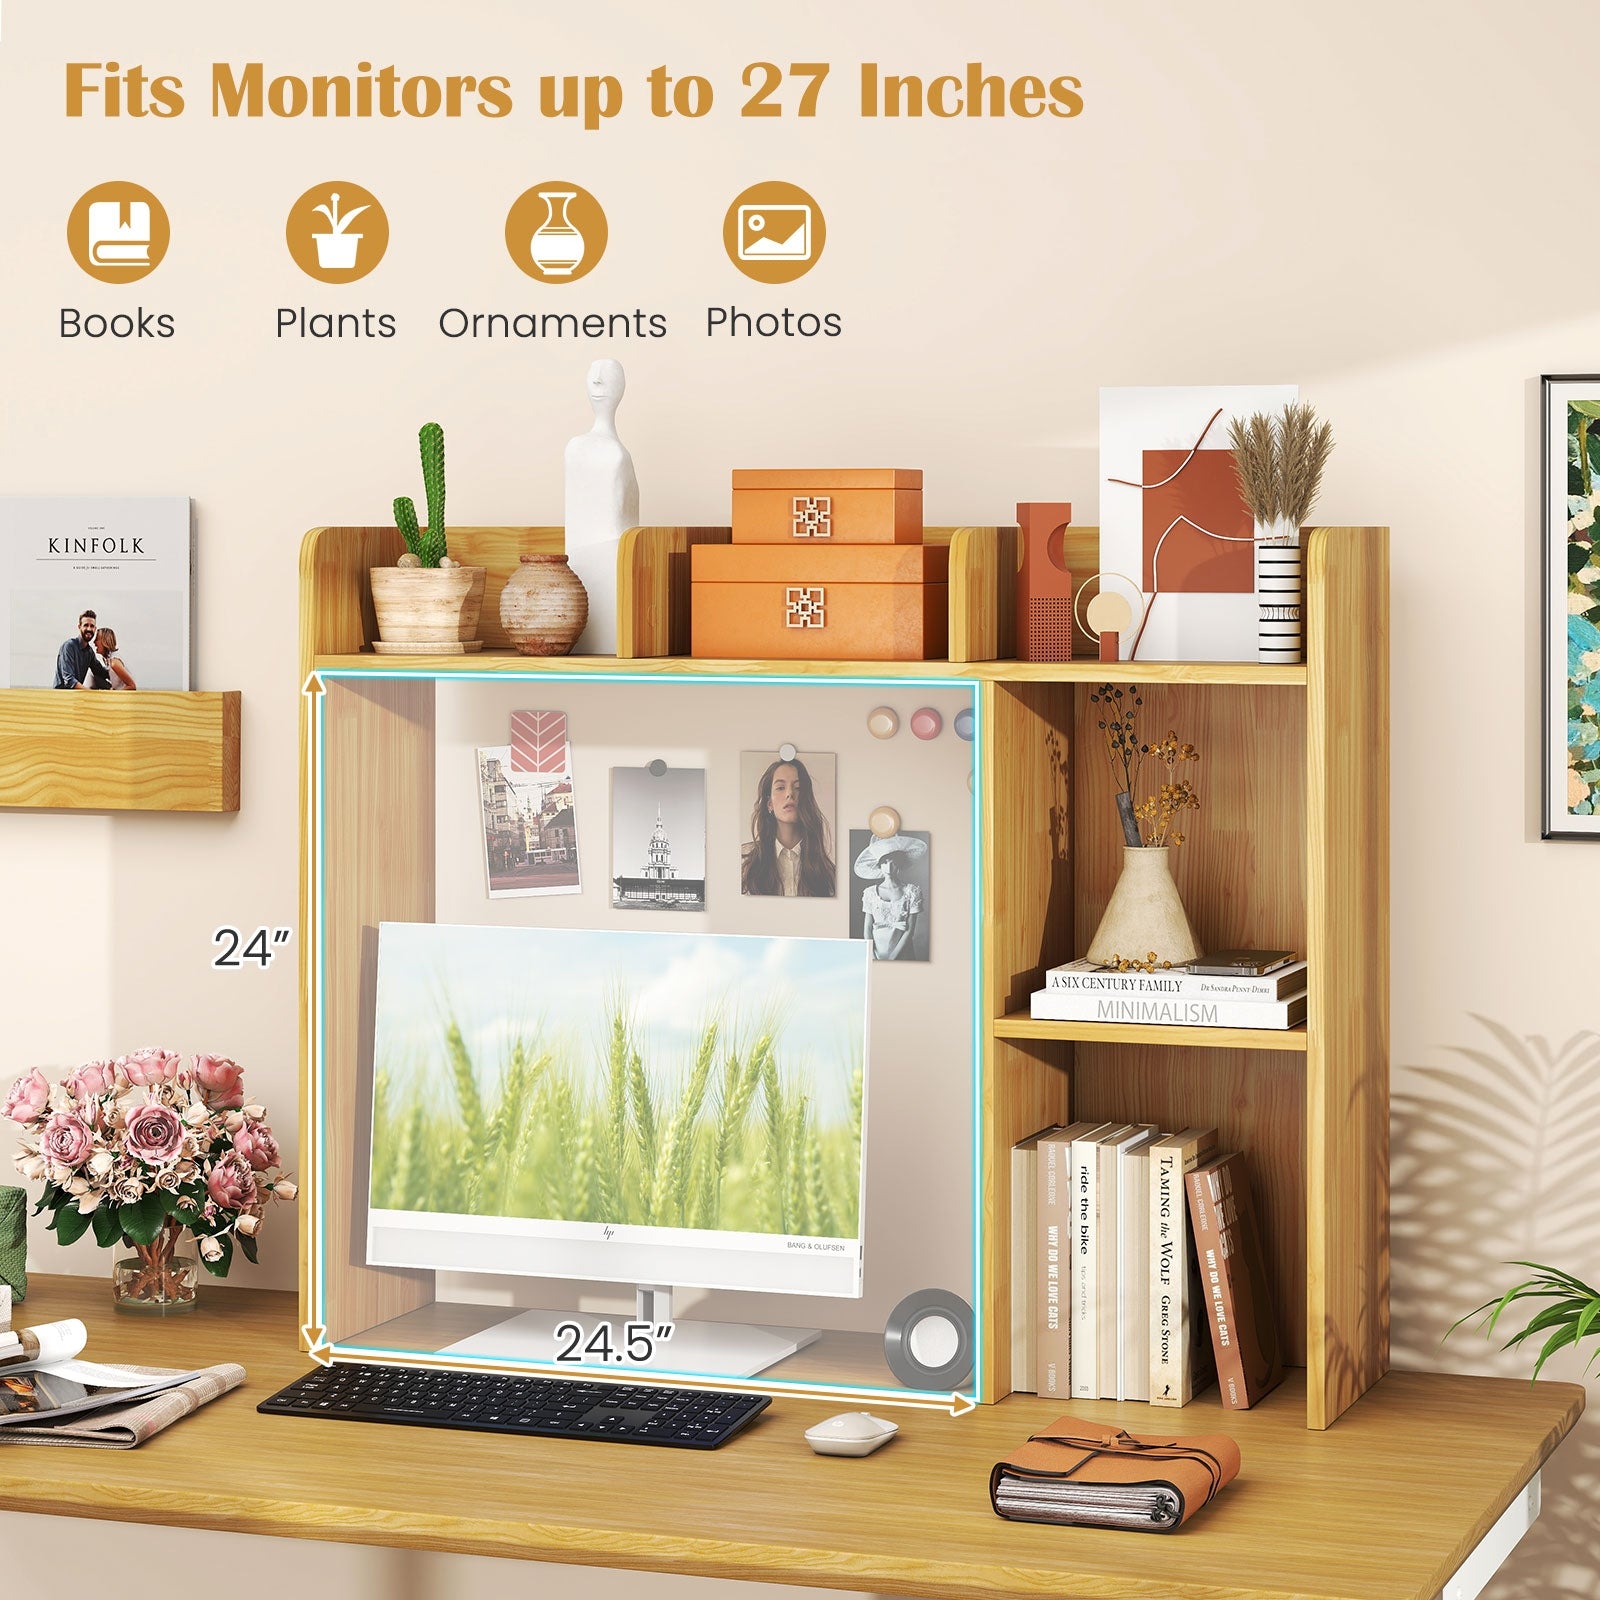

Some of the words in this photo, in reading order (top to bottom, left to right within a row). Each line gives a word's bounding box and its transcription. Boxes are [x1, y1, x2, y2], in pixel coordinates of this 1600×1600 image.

[48, 537, 144, 554] KINFOLK
[1052, 976, 1060, 988] A
[1062, 976, 1080, 988] SIX
[1082, 977, 1137, 991] CENTURY
[1139, 979, 1183, 992] FAMILY
[1097, 1000, 1218, 1023] MINIMALISM
[1080, 1166, 1089, 1194] ride
[1160, 1156, 1173, 1218] TAMING
[1080, 1198, 1089, 1221] the
[603, 1225, 615, 1240] hp
[1048, 1225, 1058, 1247] WHY
[1080, 1225, 1089, 1255] bike
[1160, 1222, 1170, 1239] the
[787, 1241, 806, 1250] BANG
[814, 1243, 846, 1252] OLUFSEN
[1048, 1248, 1058, 1262] DO
[1160, 1241, 1173, 1286] WOLF
[1205, 1249, 1217, 1271] WHY
[1048, 1264, 1058, 1280] WE
[1209, 1270, 1219, 1284] DO
[1048, 1281, 1058, 1304] LOVE
[1210, 1284, 1222, 1300] WE
[1048, 1305, 1058, 1330] CATS
[1161, 1295, 1171, 1327] GREG
[1214, 1300, 1226, 1323] LOVE
[1218, 1323, 1230, 1347] CATS
[1161, 1329, 1171, 1365] STONE
